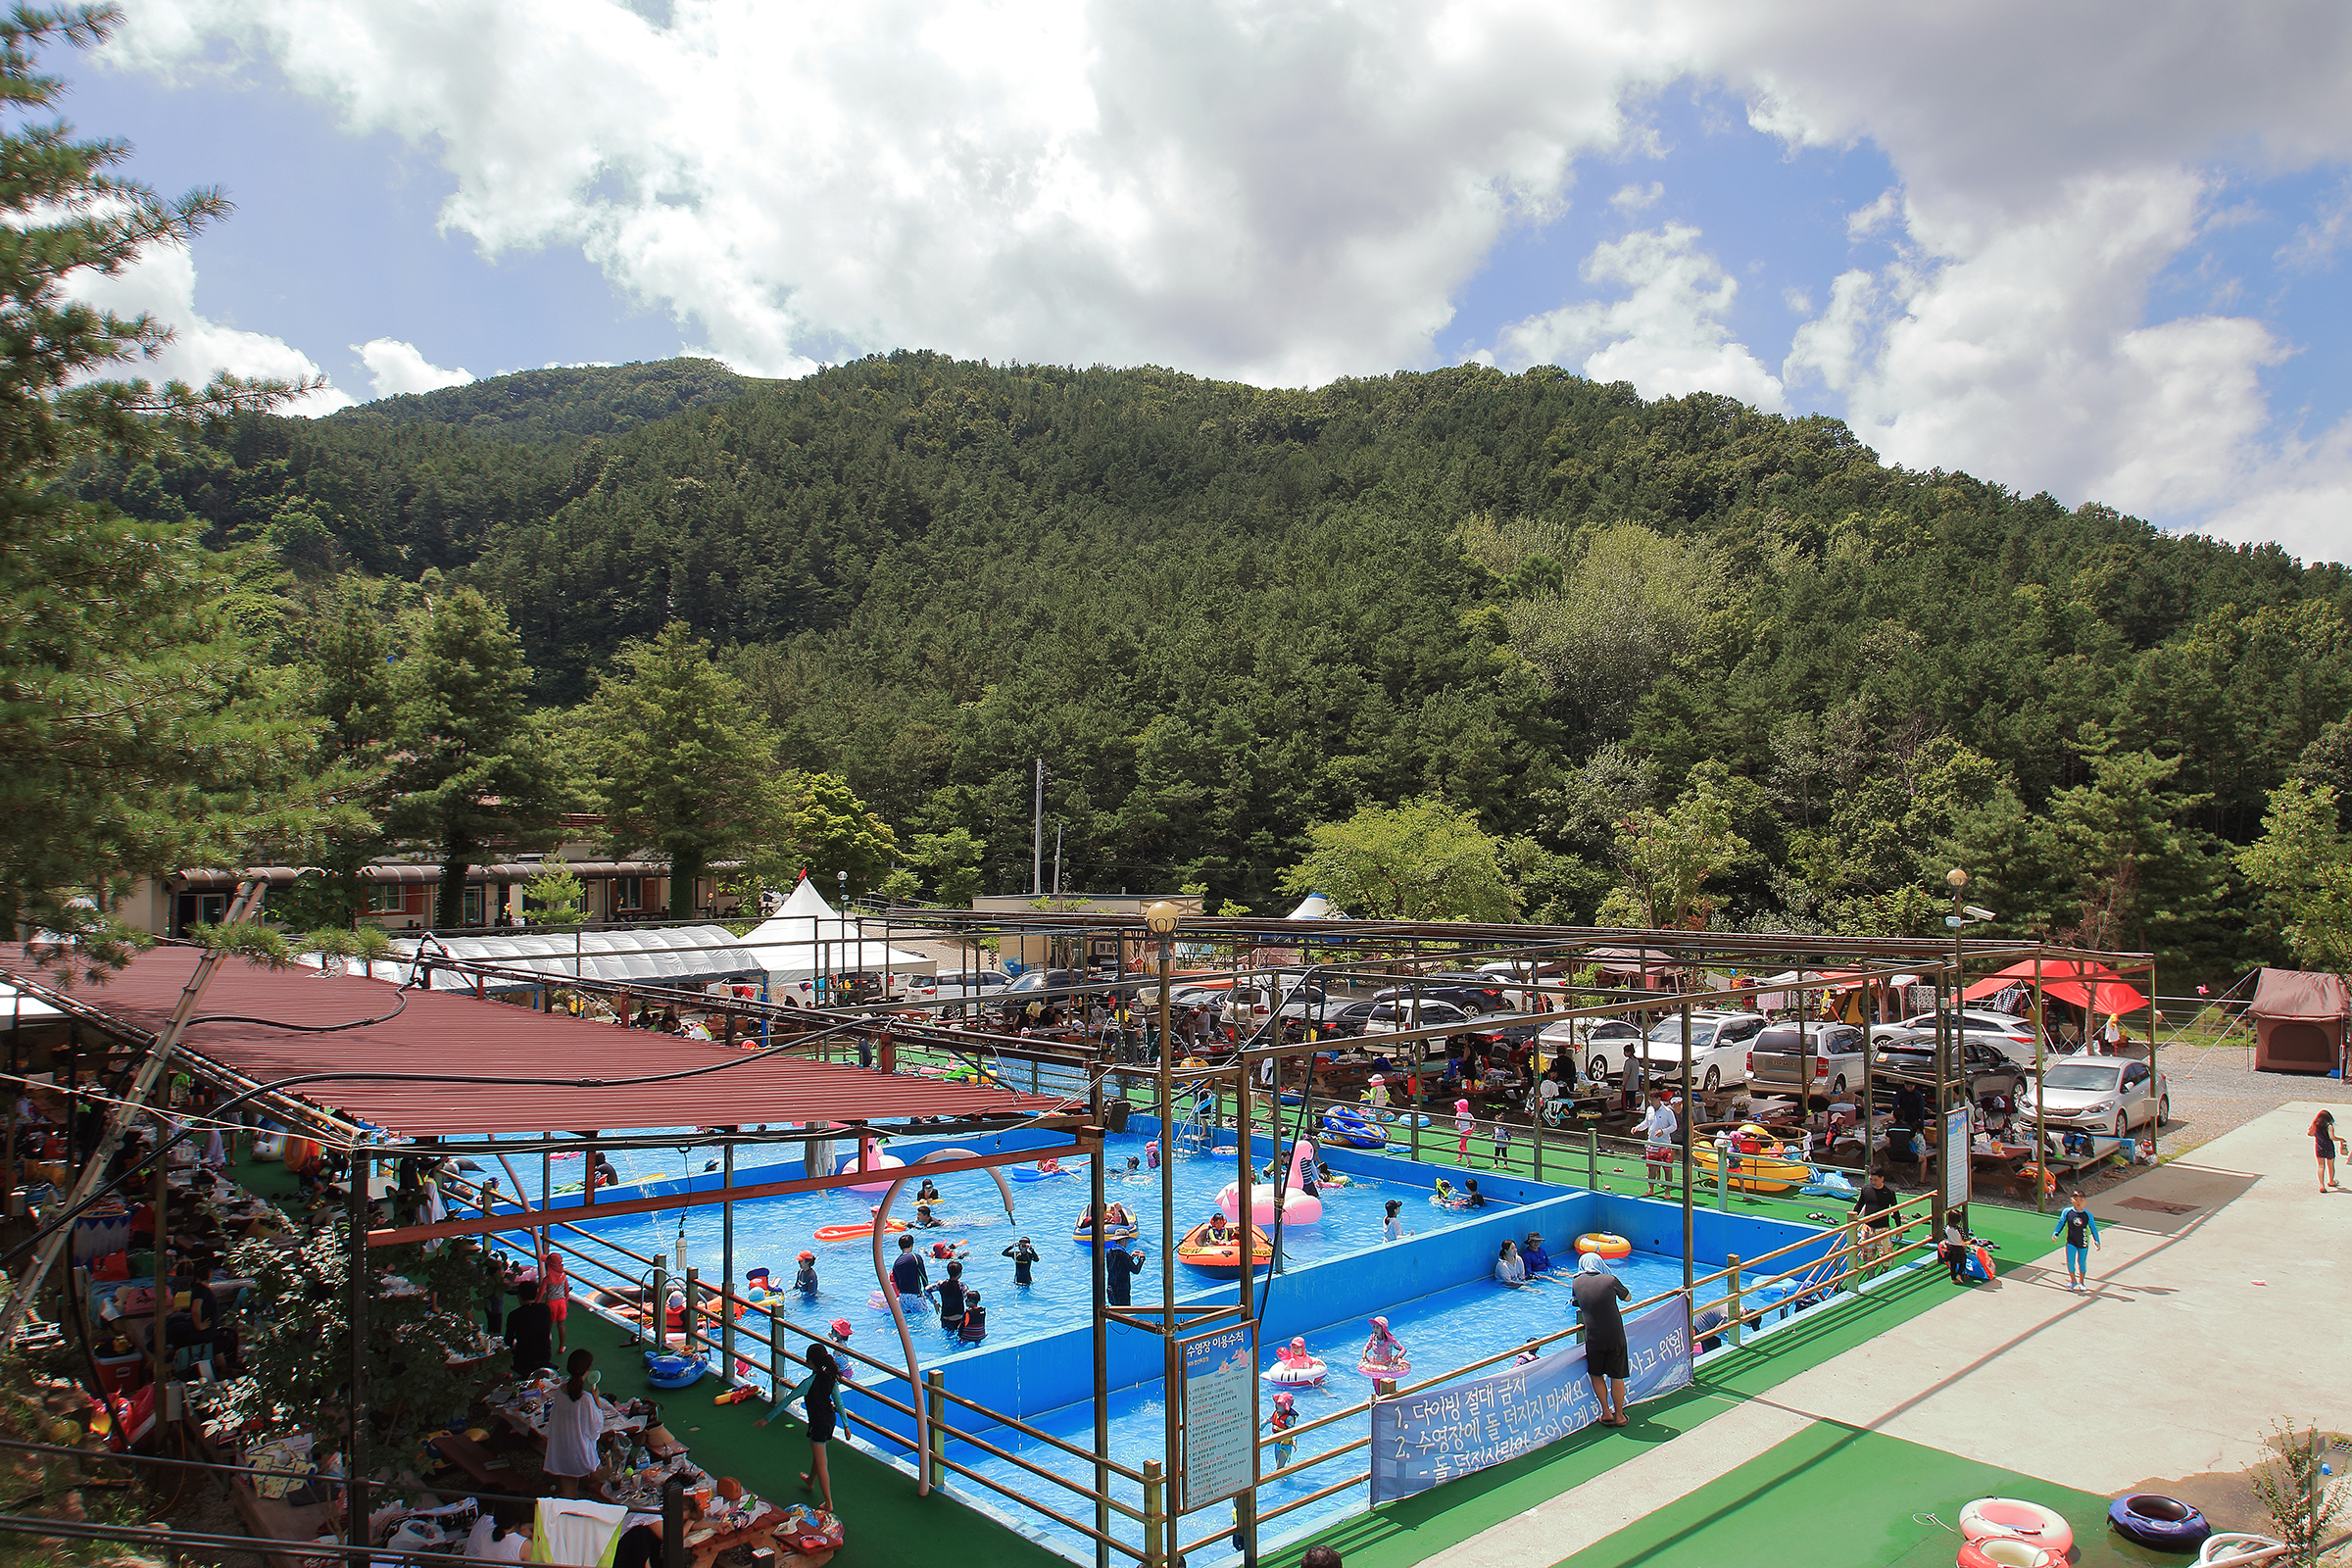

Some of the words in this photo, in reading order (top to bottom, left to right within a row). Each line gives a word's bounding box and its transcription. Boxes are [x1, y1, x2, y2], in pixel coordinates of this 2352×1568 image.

[1187, 1340, 1211, 1358] 수영장
[1212, 1330, 1245, 1349] 이용수칙
[1395, 1405, 1409, 1430] 1.
[1412, 1392, 1460, 1427] 다이빙
[1465, 1382, 1494, 1417] 절대
[1497, 1372, 1527, 1406] 금지
[1658, 1326, 1685, 1361] 위험
[1395, 1436, 1411, 1459] 2.
[1415, 1417, 1482, 1456] 수영장에
[1485, 1412, 1501, 1442] 돌
[1502, 1395, 1545, 1435] 던지지
[1545, 1380, 1589, 1413] 마세요
[1433, 1455, 1452, 1485] 돌
